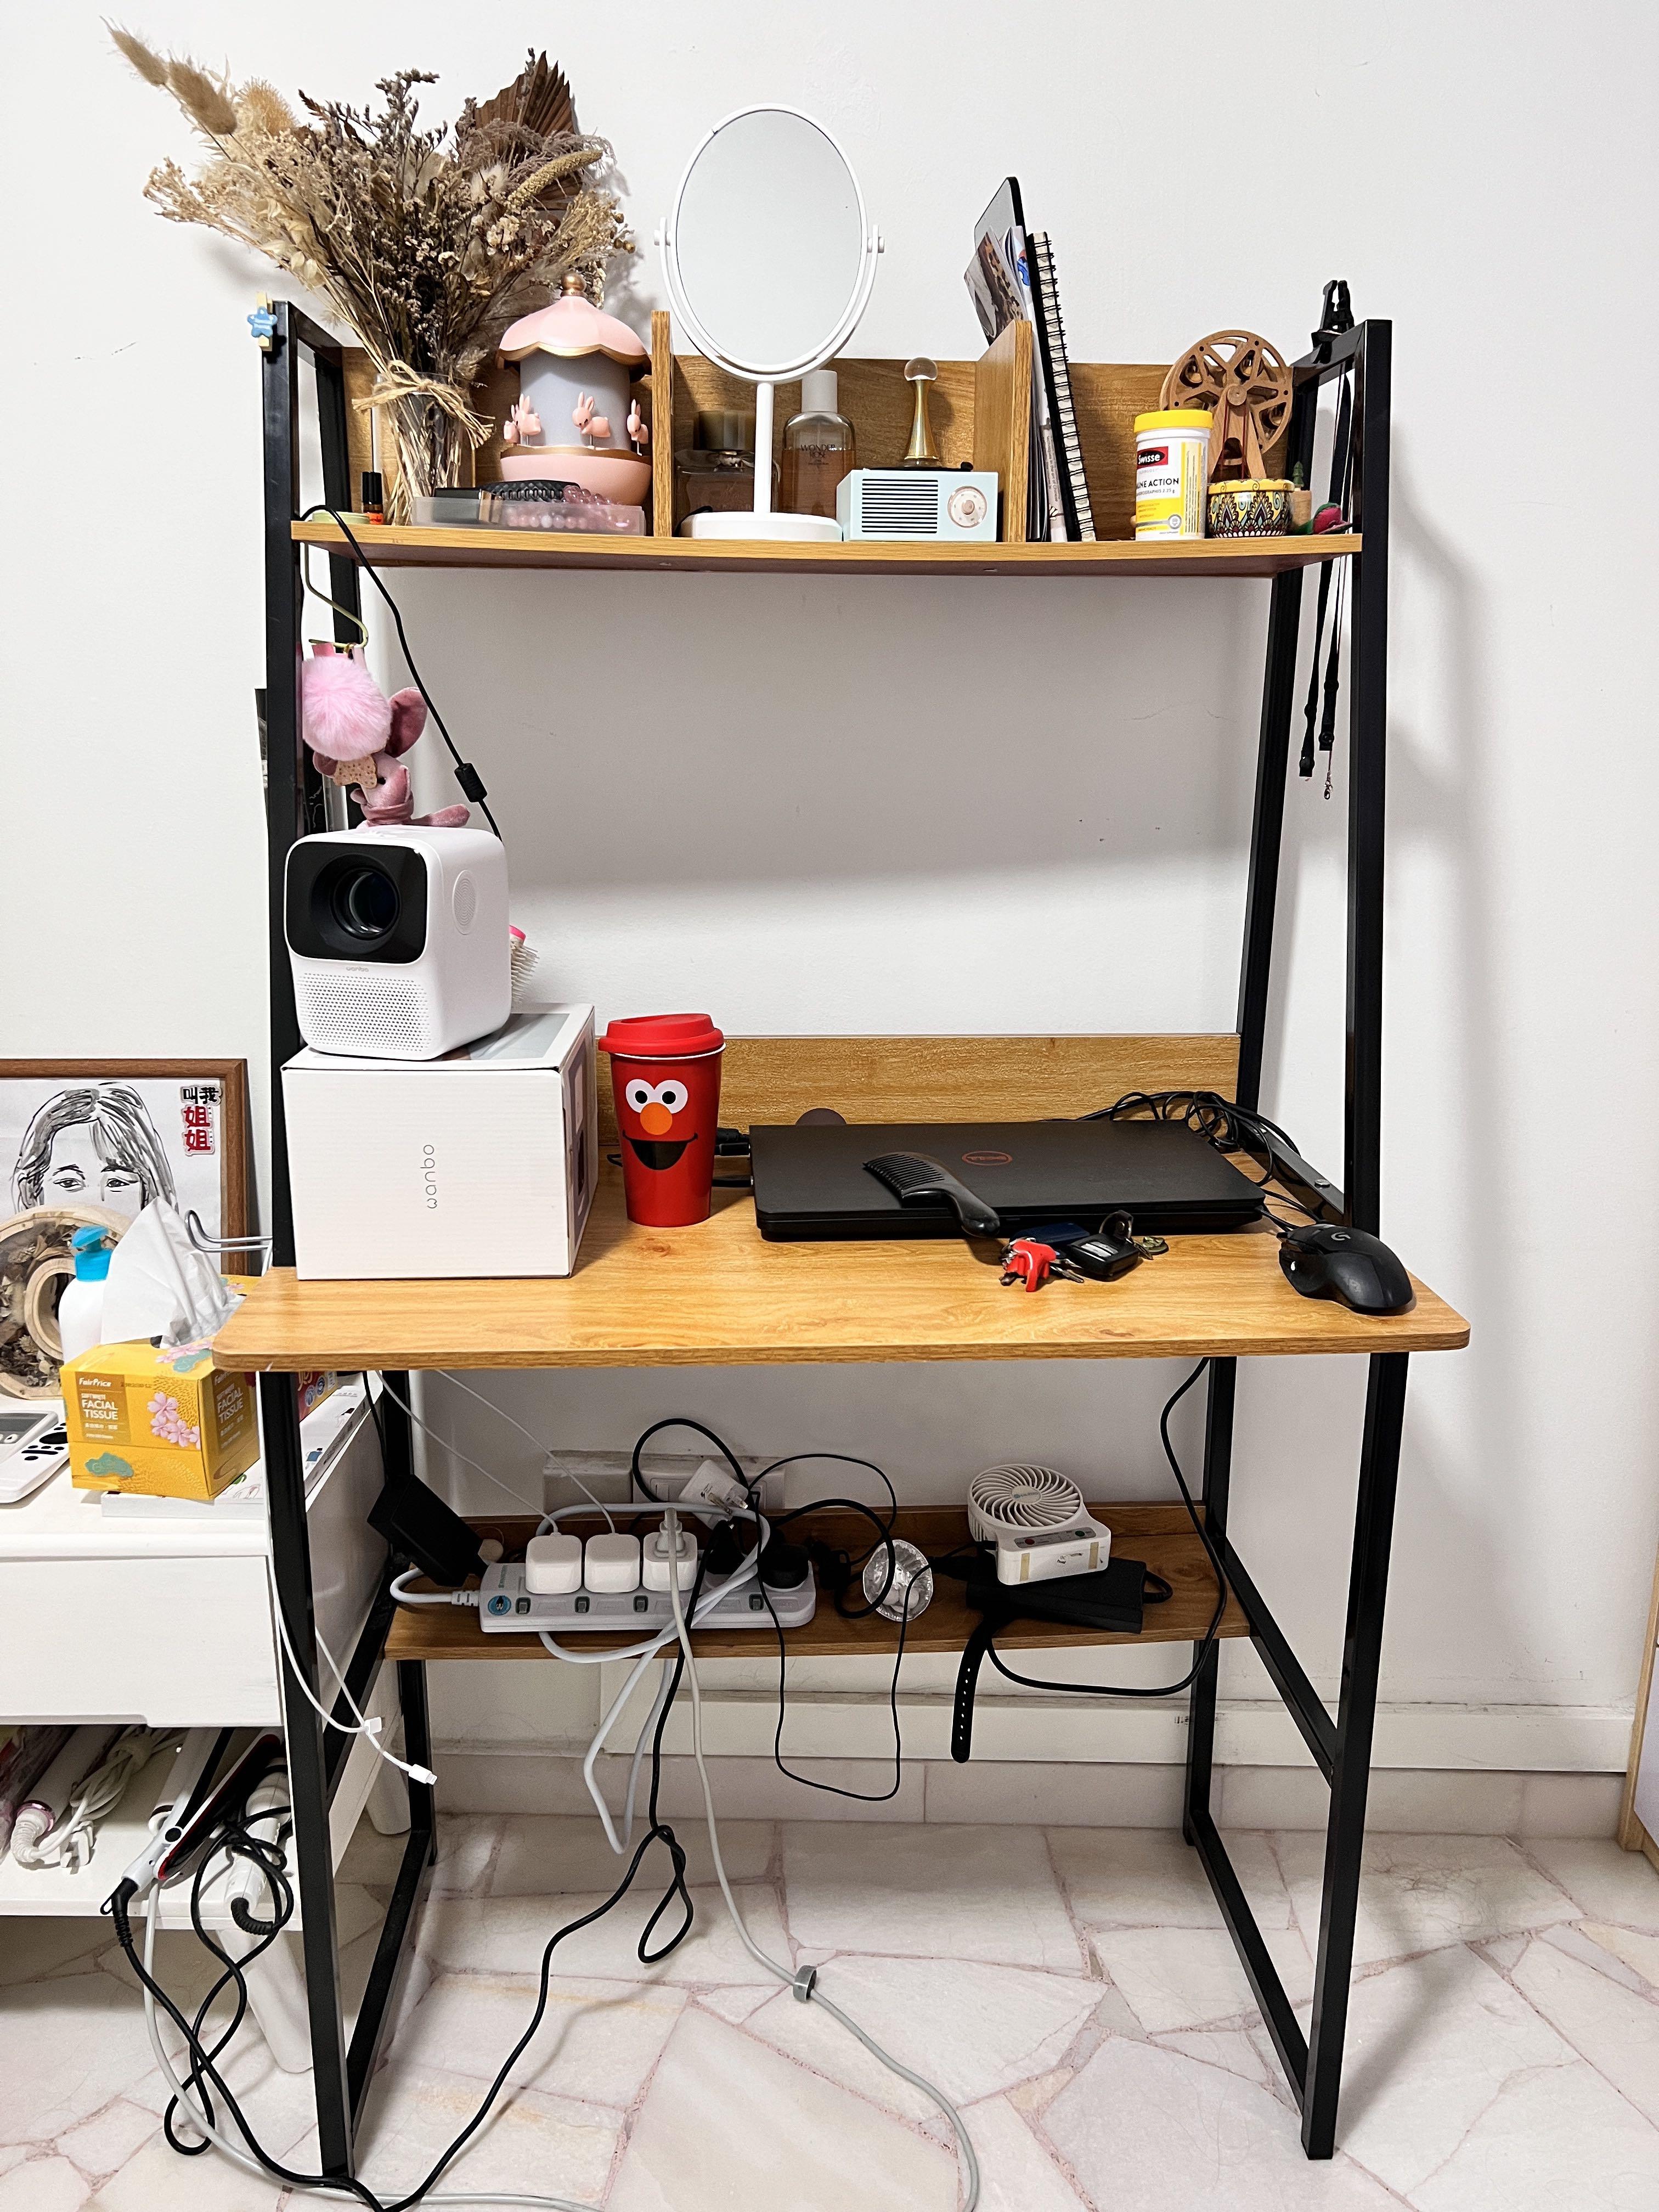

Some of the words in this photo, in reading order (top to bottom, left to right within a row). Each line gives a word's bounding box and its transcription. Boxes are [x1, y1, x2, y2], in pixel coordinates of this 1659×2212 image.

[1138, 454, 1160, 465] Swisse
[1148, 477, 1179, 487] ACTION
[183, 1087, 219, 1104] 叫我
[420, 1145, 438, 1209] wanbo
[78, 1377, 112, 1387] FairPrice
[82, 1399, 119, 1410] FACIAL
[217, 1387, 244, 1414] FACIAL
[83, 1409, 119, 1420] TISSUE
[219, 1397, 243, 1424] TISSUE
